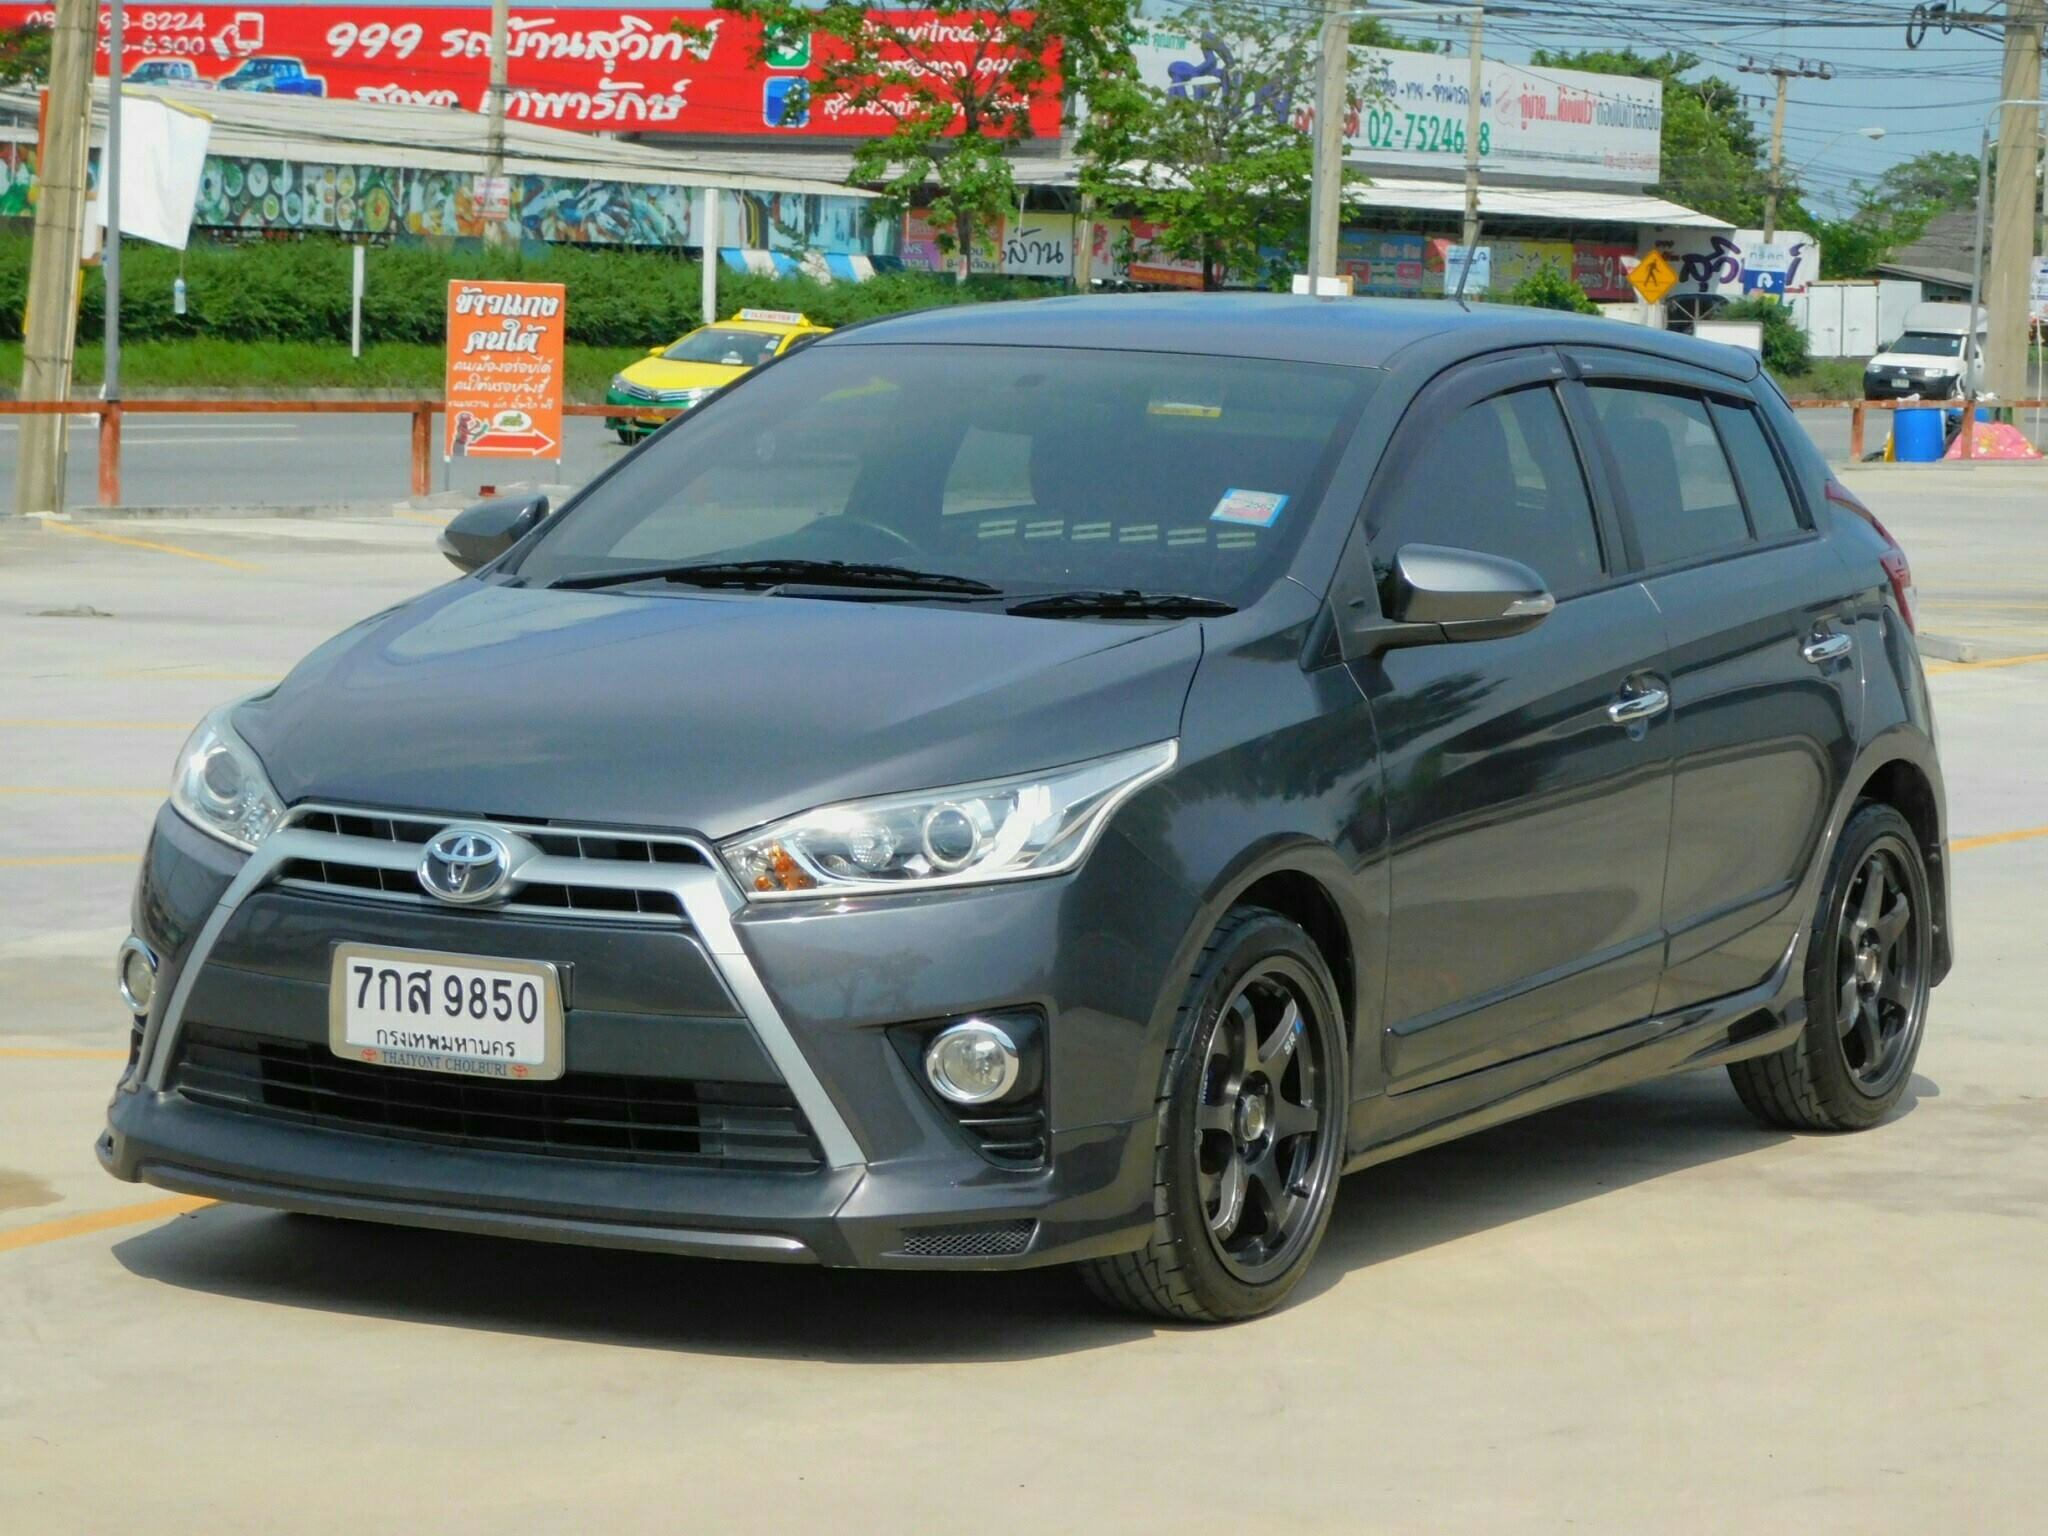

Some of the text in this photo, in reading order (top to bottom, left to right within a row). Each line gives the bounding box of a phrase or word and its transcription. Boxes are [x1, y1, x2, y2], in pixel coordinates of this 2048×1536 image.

[326, 22, 423, 60] 999
[1367, 108, 1490, 156] 02-752468
[455, 286, 561, 318] ข้าวแกง
[463, 318, 547, 354] คนใต้
[353, 966, 538, 1024] 7กส 9850
[376, 1028, 516, 1058] กรงเทพมหานคร
[382, 1051, 508, 1077] THAIYONT CHOLBURI
